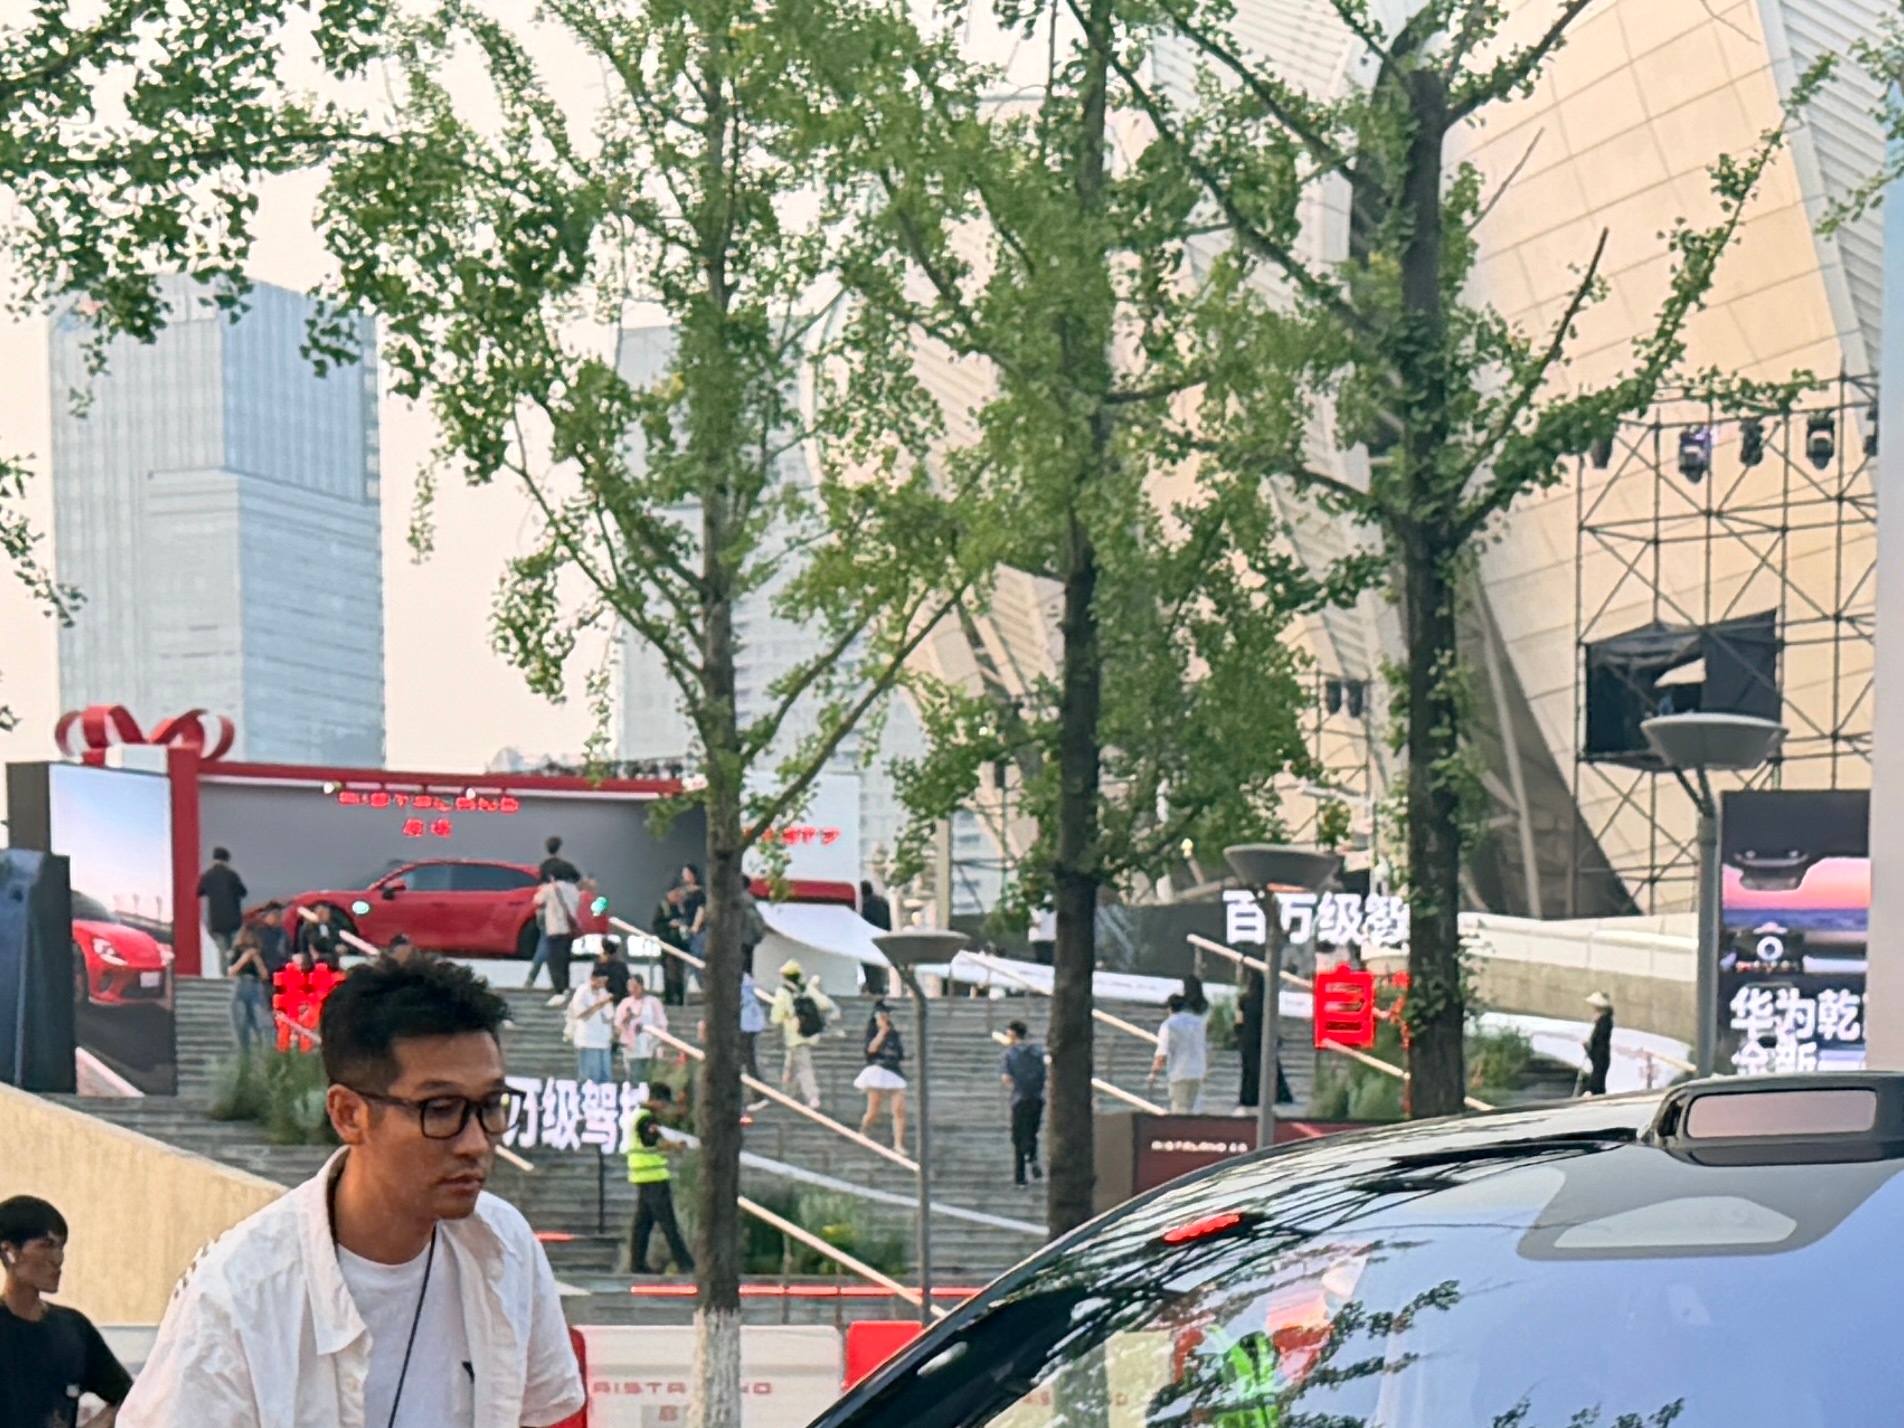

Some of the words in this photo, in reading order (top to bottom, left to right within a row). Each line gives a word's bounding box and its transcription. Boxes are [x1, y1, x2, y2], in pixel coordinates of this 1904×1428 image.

[1730, 986, 1869, 1041] 华为乾
[593, 1381, 773, 1395] AISTAD
